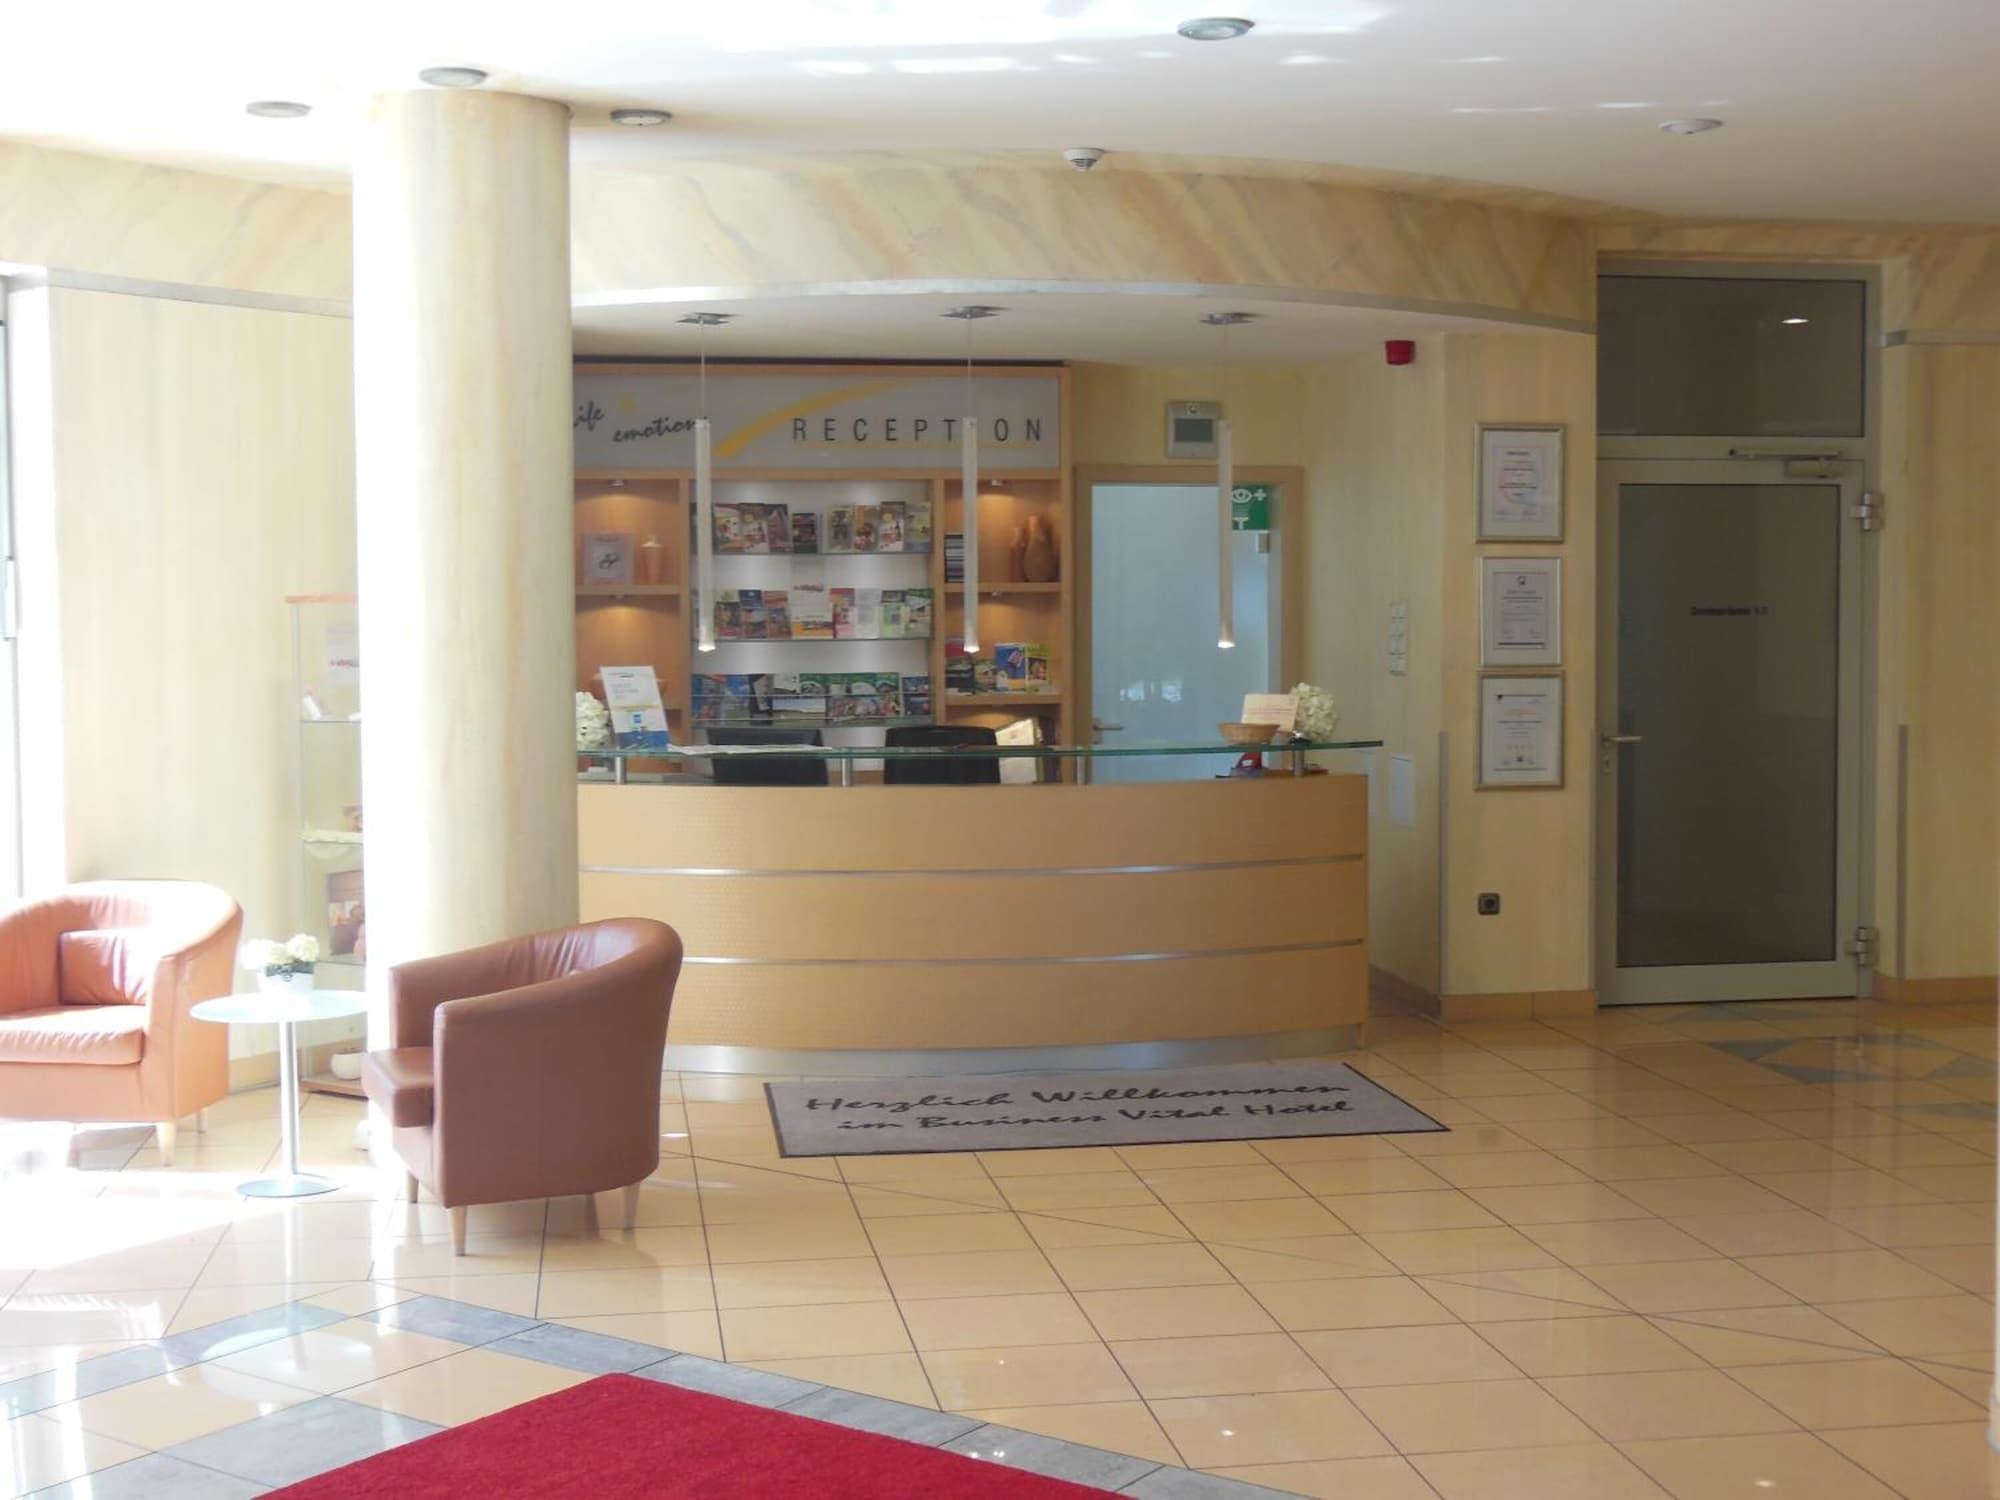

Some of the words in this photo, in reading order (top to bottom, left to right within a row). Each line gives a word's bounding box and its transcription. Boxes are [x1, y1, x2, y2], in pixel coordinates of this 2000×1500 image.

[573, 399, 605, 432] ife
[792, 418, 1041, 442] RECEPTON
[806, 1092, 1014, 1112] Herzlich
[1031, 1085, 1350, 1103] Willkommen
[837, 1120, 904, 1128] im
[916, 1114, 1106, 1129] Business
[1118, 1105, 1230, 1121] Vital
[1244, 1101, 1354, 1116] Hotel
